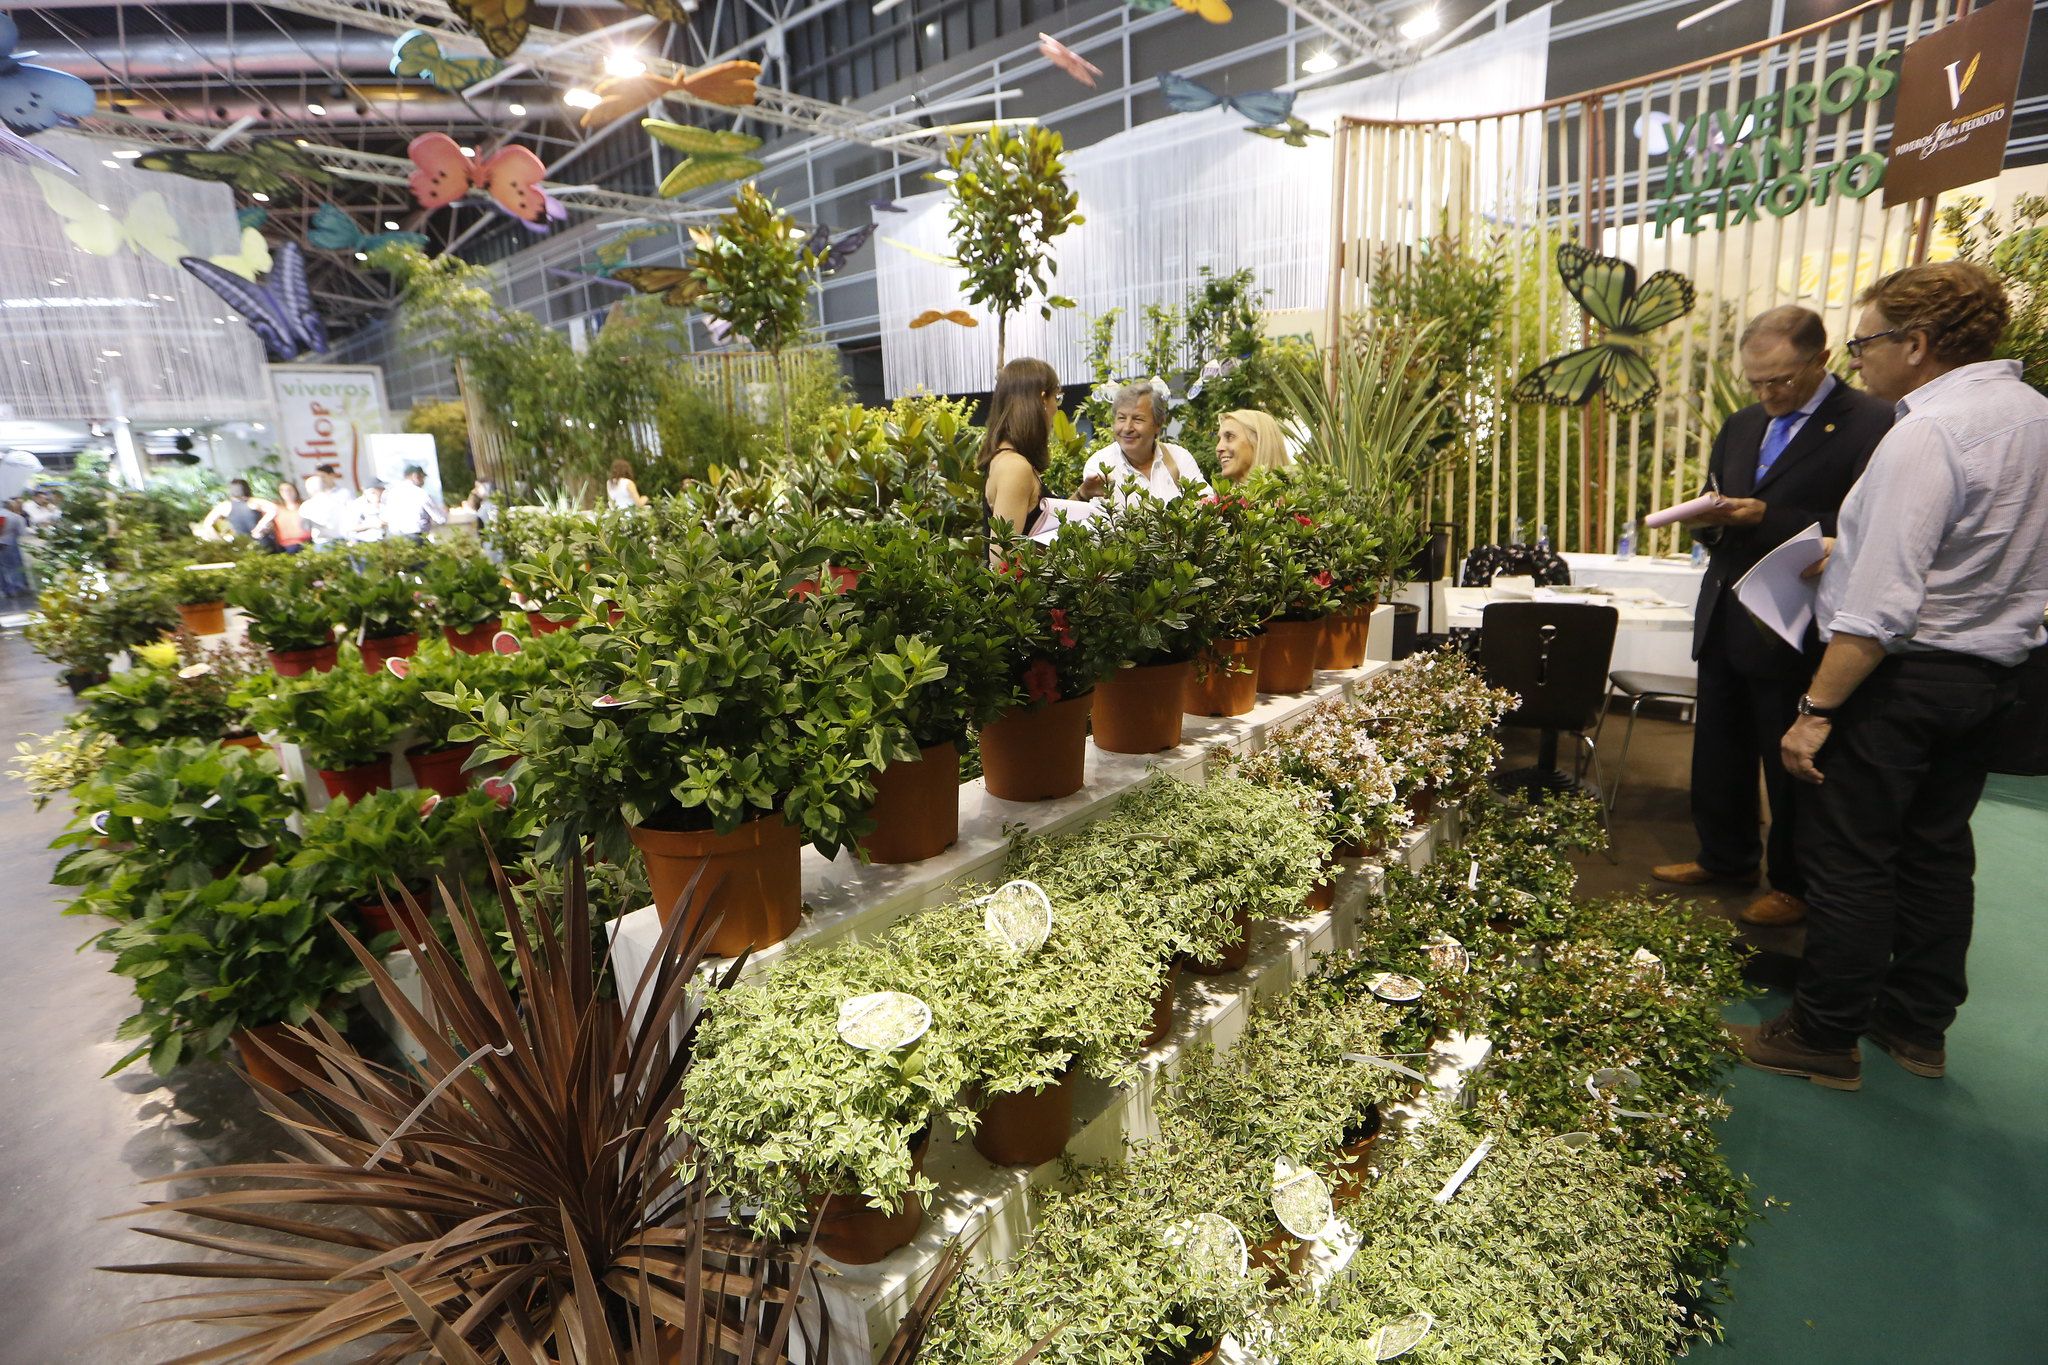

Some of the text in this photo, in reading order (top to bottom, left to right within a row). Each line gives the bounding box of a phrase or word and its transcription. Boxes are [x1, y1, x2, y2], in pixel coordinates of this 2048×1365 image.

[1662, 49, 1900, 158] VIVEROS
[1960, 109, 2005, 133] PEIXOTO
[1655, 152, 1887, 238] PEIXOTO
[1656, 128, 1804, 199] JUAN
[282, 379, 371, 397] viveros
